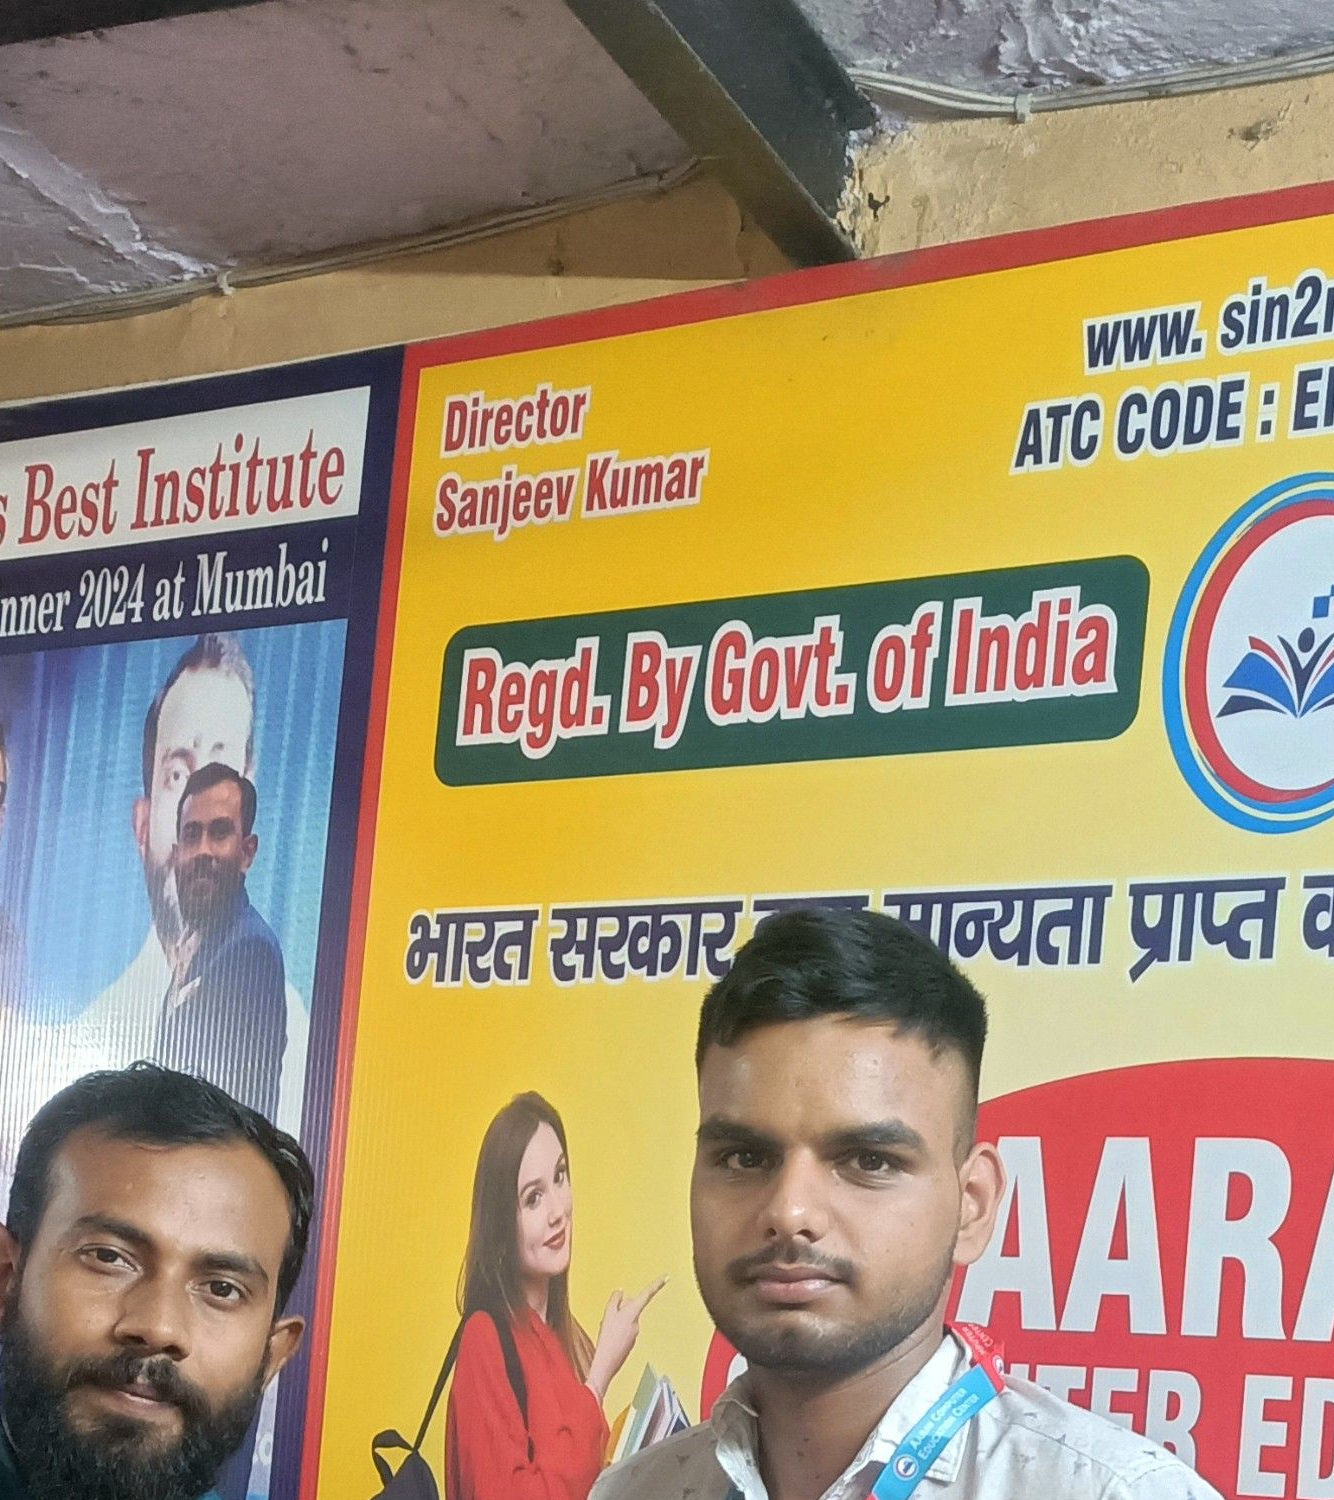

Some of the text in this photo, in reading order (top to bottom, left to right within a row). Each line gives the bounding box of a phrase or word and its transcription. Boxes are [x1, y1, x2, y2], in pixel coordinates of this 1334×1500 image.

[1086, 308, 1204, 369] www.
[444, 387, 588, 452] Director
[1014, 402, 1100, 469] ATC
[1116, 381, 1246, 456] CODE
[1259, 391, 1276, 438] :
[18, 458, 119, 546] Best
[130, 427, 346, 532] Institute
[435, 453, 706, 536] Sanjeev Kumar
[75, 563, 146, 630] 2024
[153, 573, 185, 620] at
[192, 537, 329, 617] Mumbai
[461, 596, 1111, 750] Regd. By Govt. of India
[404, 908, 538, 985] भारत
[549, 901, 742, 982] सरकार
[1128, 877, 1287, 984] प्राप्त
